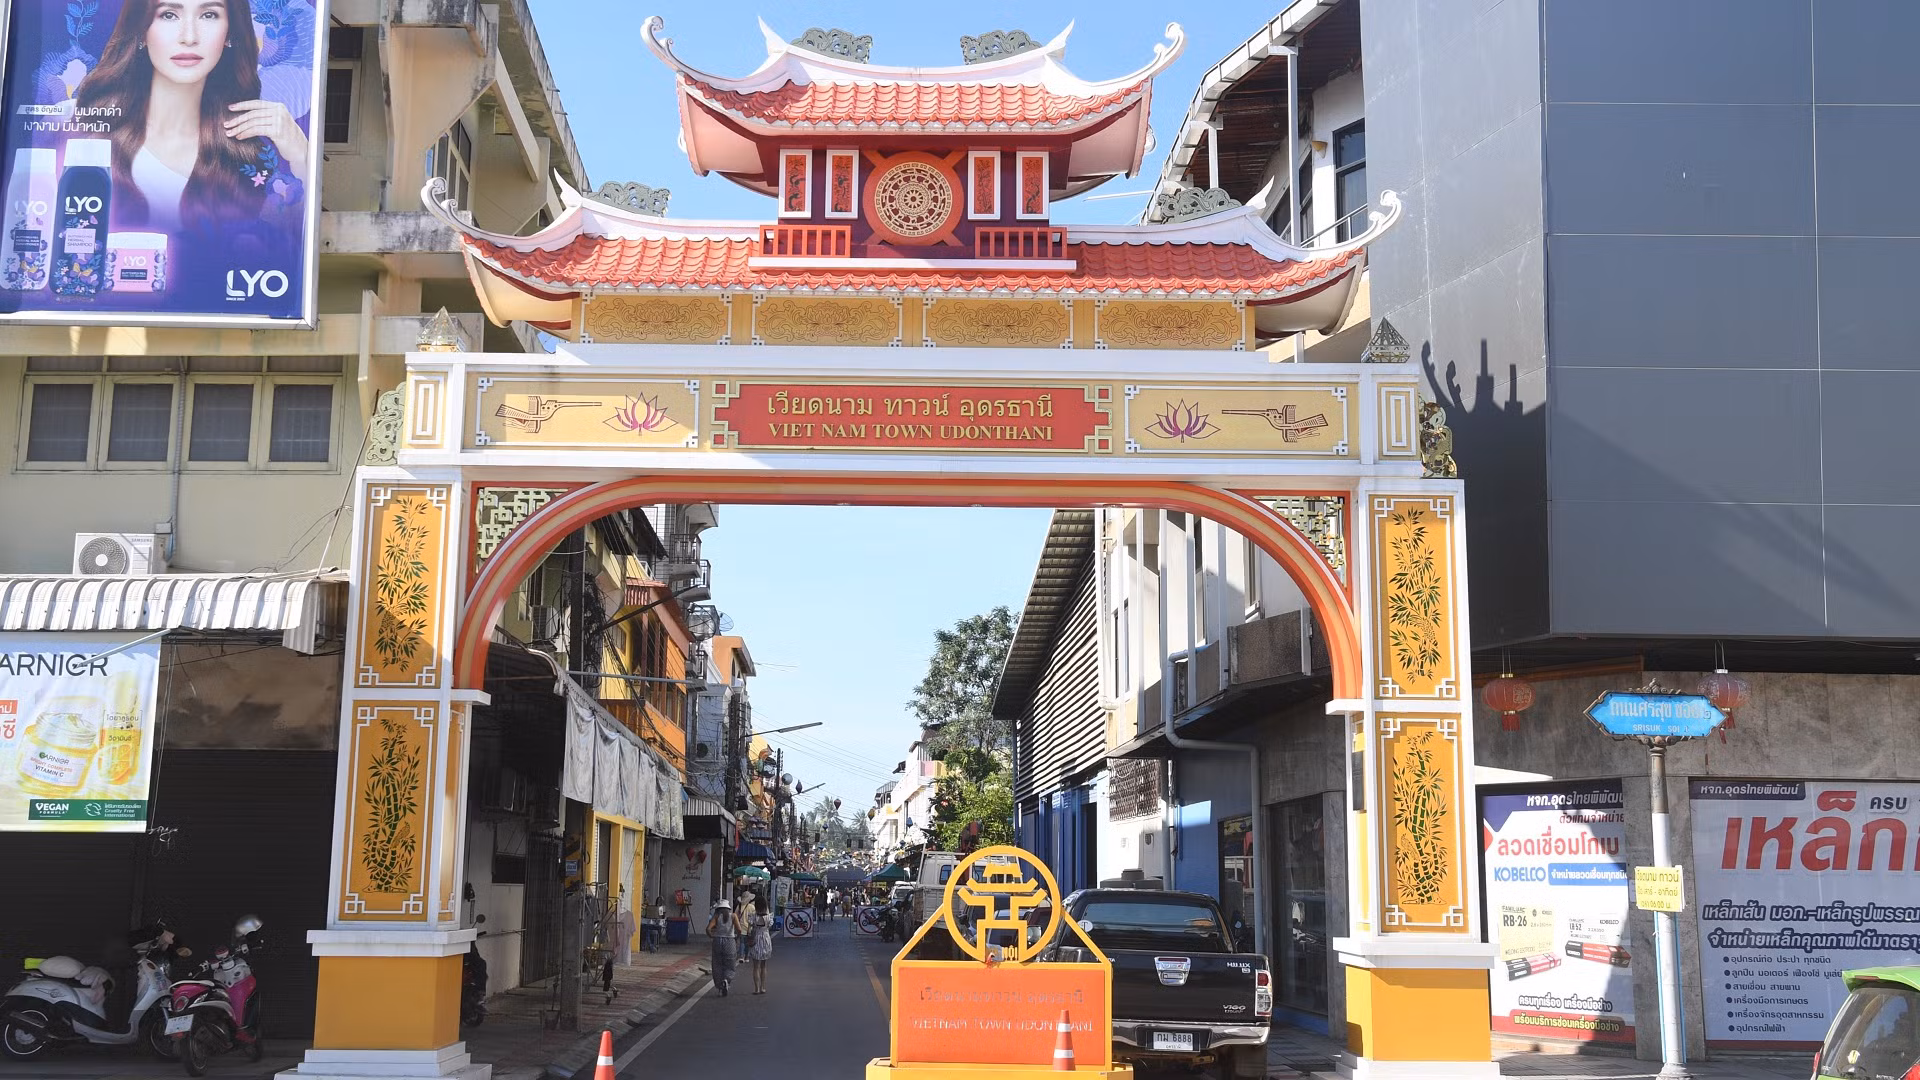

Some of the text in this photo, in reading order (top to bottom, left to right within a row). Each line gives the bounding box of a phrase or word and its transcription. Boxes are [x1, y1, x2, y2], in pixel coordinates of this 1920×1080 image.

[23, 116, 111, 133] เงางาม มีน้ำหนัก
[65, 196, 103, 213] LYO
[226, 269, 289, 298] LYO
[767, 391, 1054, 423] เวียดนาม ทาวน์ อุดรธานี
[767, 422, 1054, 442] VIET NAM TOWN UDONTHANI
[1632, 724, 1661, 732] SRISUK
[1667, 725, 1680, 733] SOI
[35, 764, 59, 776] VITAMIN
[1700, 783, 1800, 798] หจก.อุดรไทยพิพัฒน์
[35, 802, 70, 812] VEGAN
[1869, 796, 1908, 810] ครบ
[1721, 790, 1920, 872] เหล็ก
[1497, 825, 1619, 856] ลวดเชื่อมโกเบ
[1493, 866, 1547, 882] KOBELCO
[1703, 900, 1766, 921] เหล็กเส้น
[1503, 914, 1528, 927] RB-26
[1776, 956, 1800, 964] ประปา
[1803, 955, 1831, 966] ทุกชนิด
[1758, 968, 1789, 978] มอเตอร์
[1732, 980, 1801, 991] สายเชื่อม สายพาน
[1733, 993, 1809, 1005] เครื่องมือการเกษตร
[1172, 1034, 1192, 1043] 6888
